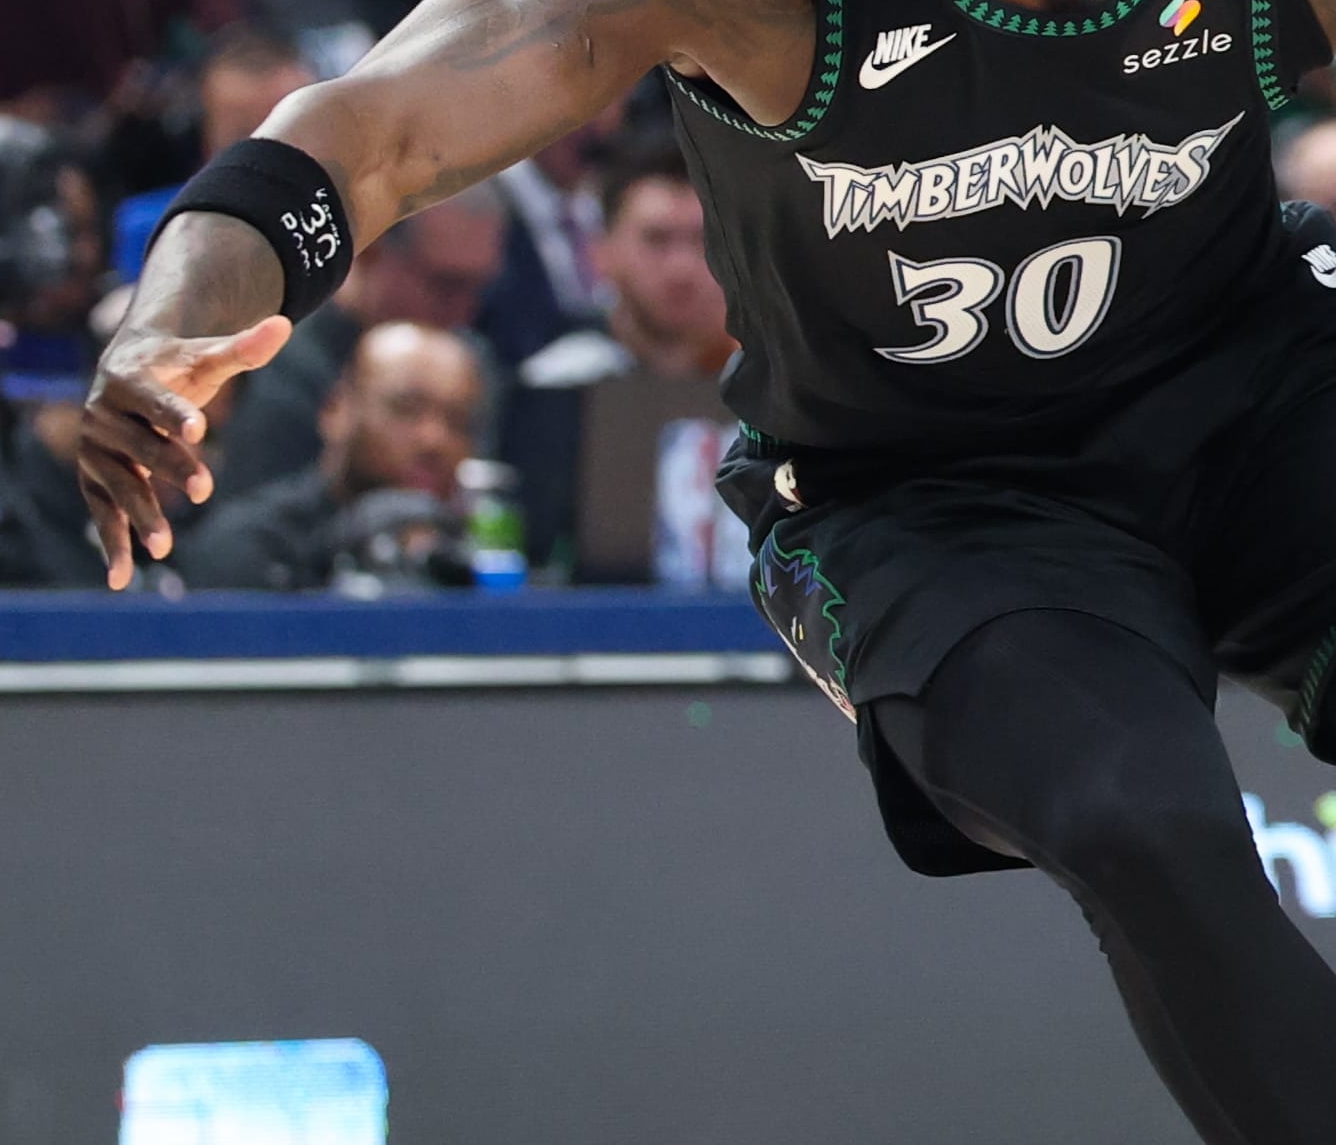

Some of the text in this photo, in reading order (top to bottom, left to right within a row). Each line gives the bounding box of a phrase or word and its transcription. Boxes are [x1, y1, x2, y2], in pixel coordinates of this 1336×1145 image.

[873, 23, 933, 65] NIKE
[1122, 29, 1233, 74] sezzle
[795, 111, 1246, 239] TIMBERWOLVES
[873, 235, 1122, 364] 30
